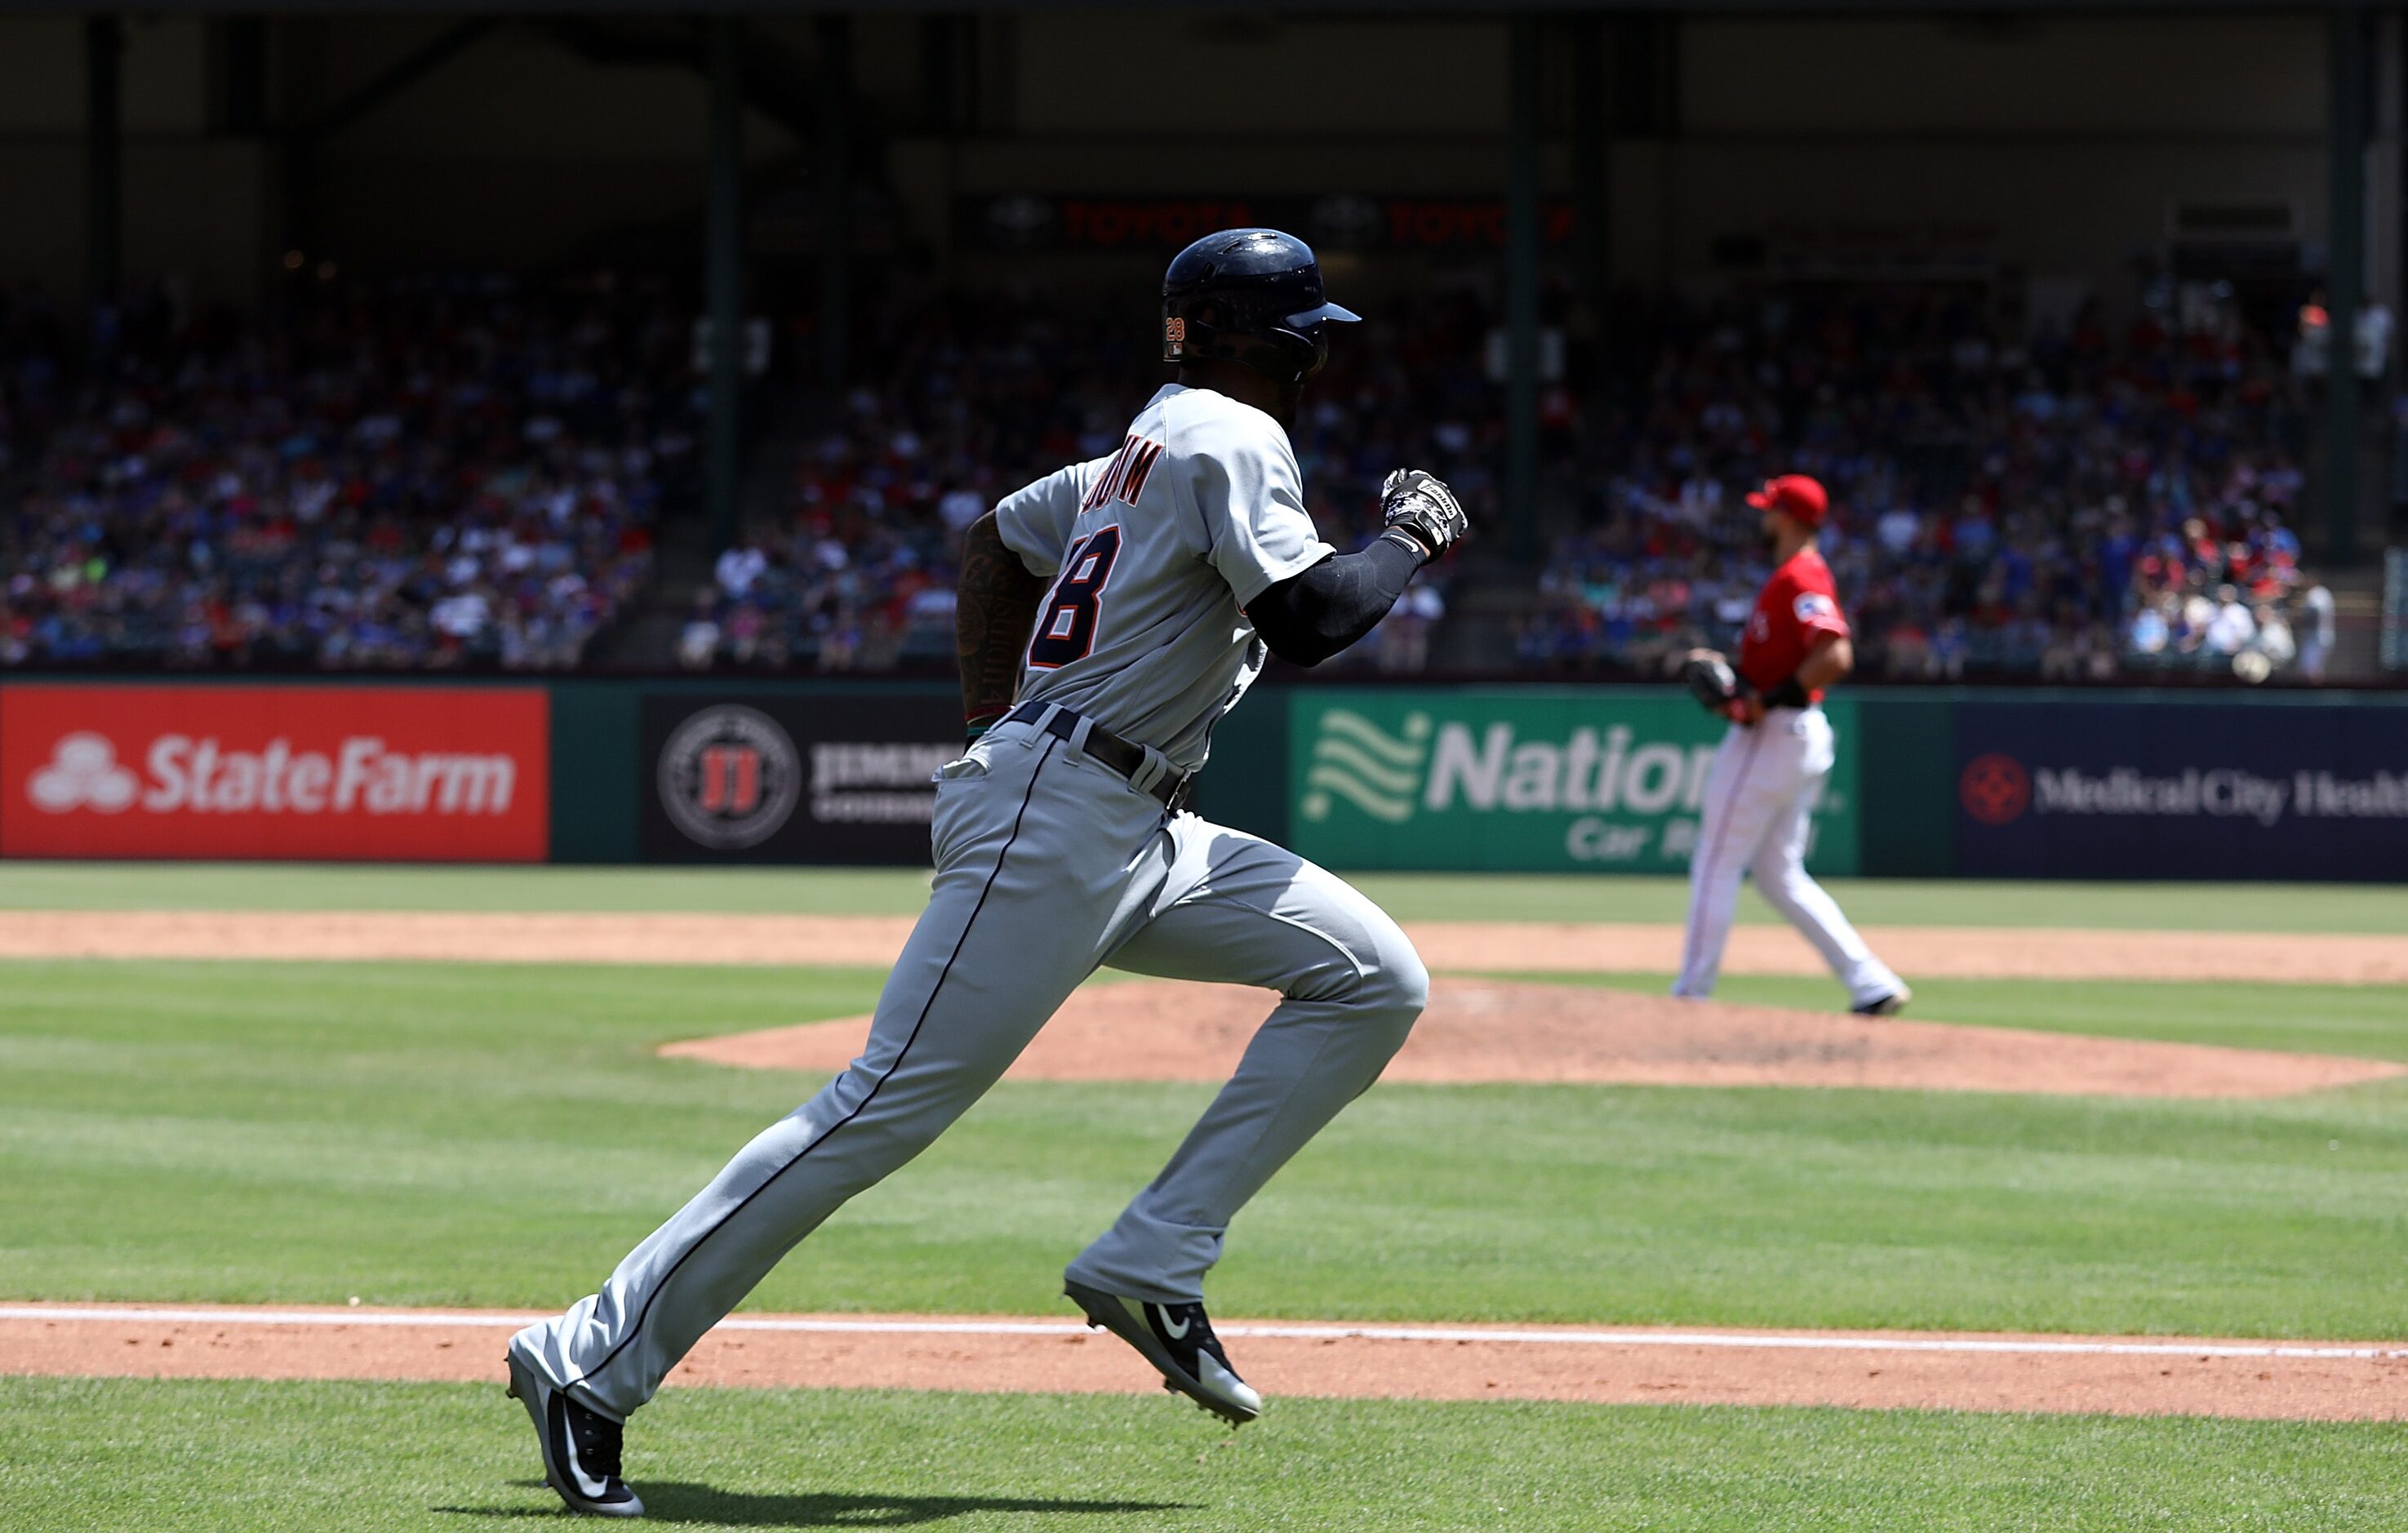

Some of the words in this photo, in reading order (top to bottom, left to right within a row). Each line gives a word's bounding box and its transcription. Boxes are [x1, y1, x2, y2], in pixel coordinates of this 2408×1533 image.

[1166, 317, 1184, 341] 28
[1025, 523, 1123, 671] 8
[2037, 769, 2199, 813] Medical
[2203, 771, 2285, 824] City
[1568, 819, 1652, 858] Car
